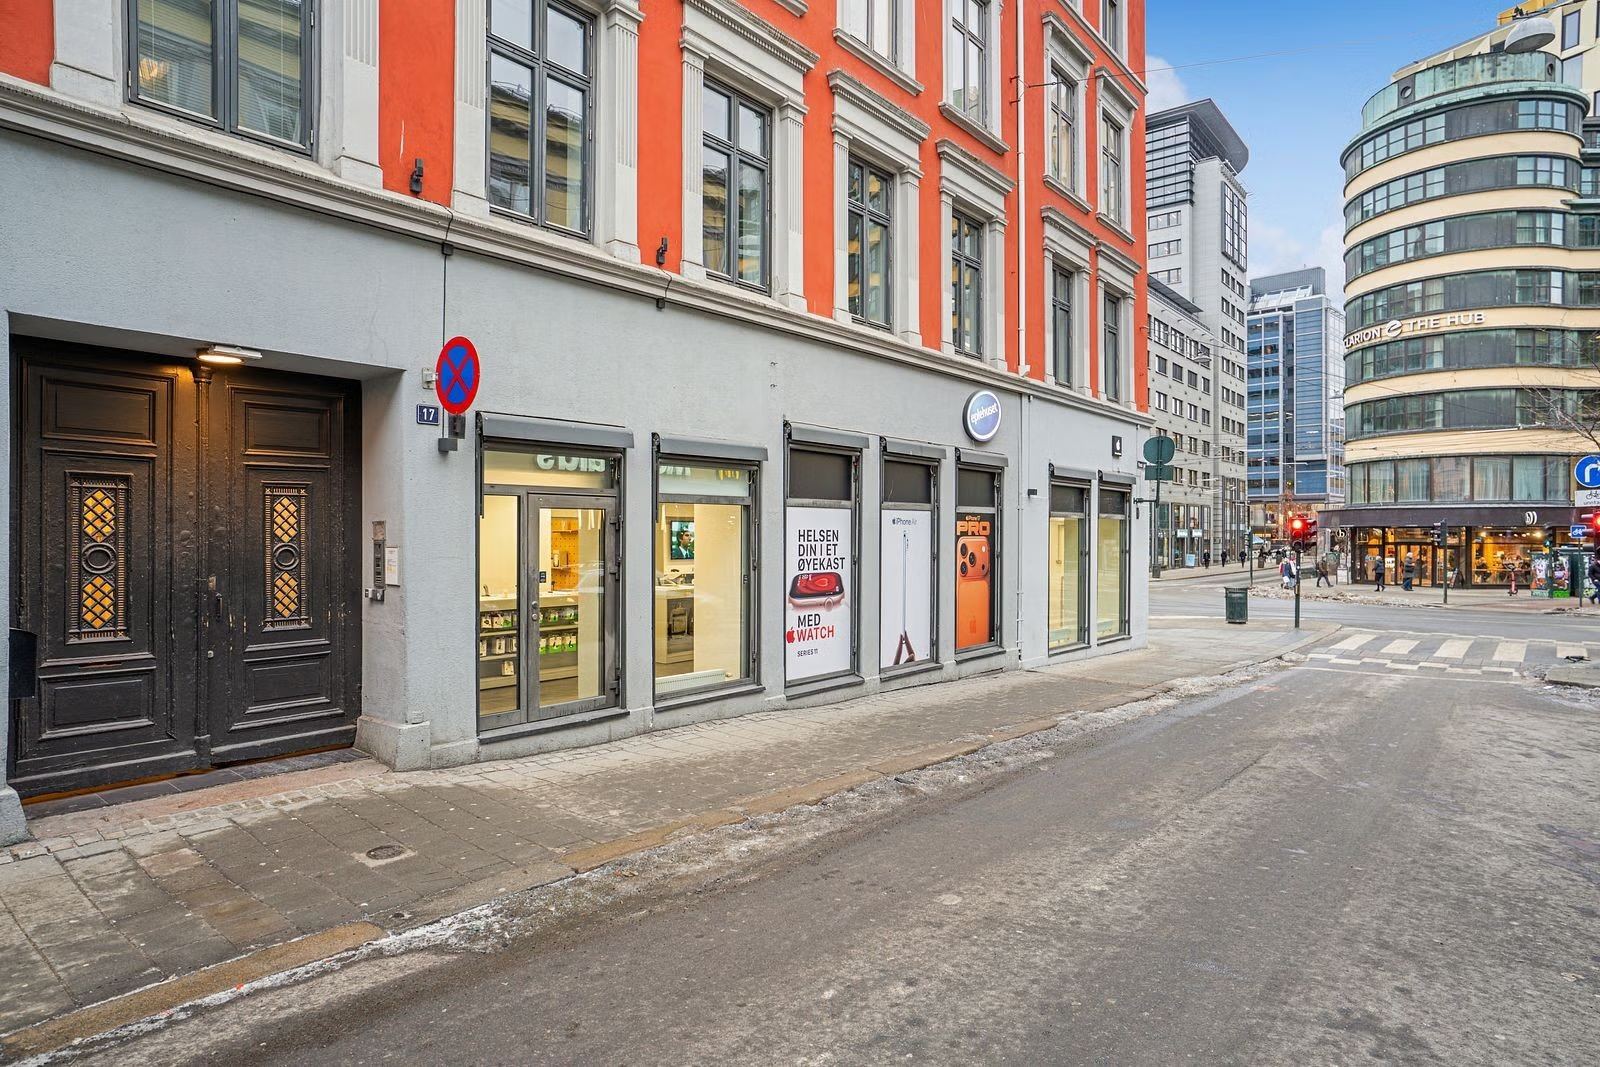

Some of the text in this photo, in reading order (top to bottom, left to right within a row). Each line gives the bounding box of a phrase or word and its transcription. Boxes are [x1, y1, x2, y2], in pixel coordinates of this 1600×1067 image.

[1408, 318, 1441, 331] THE
[1447, 312, 1486, 326] HUB
[422, 408, 435, 421] 17
[798, 529, 839, 542] HELSEN
[956, 521, 991, 536] PRO
[798, 543, 838, 557] DIN I ET
[797, 557, 846, 571] ØYEKAST
[797, 613, 821, 628] MED
[796, 625, 834, 642] WATCH
[797, 648, 814, 658] SERIES
